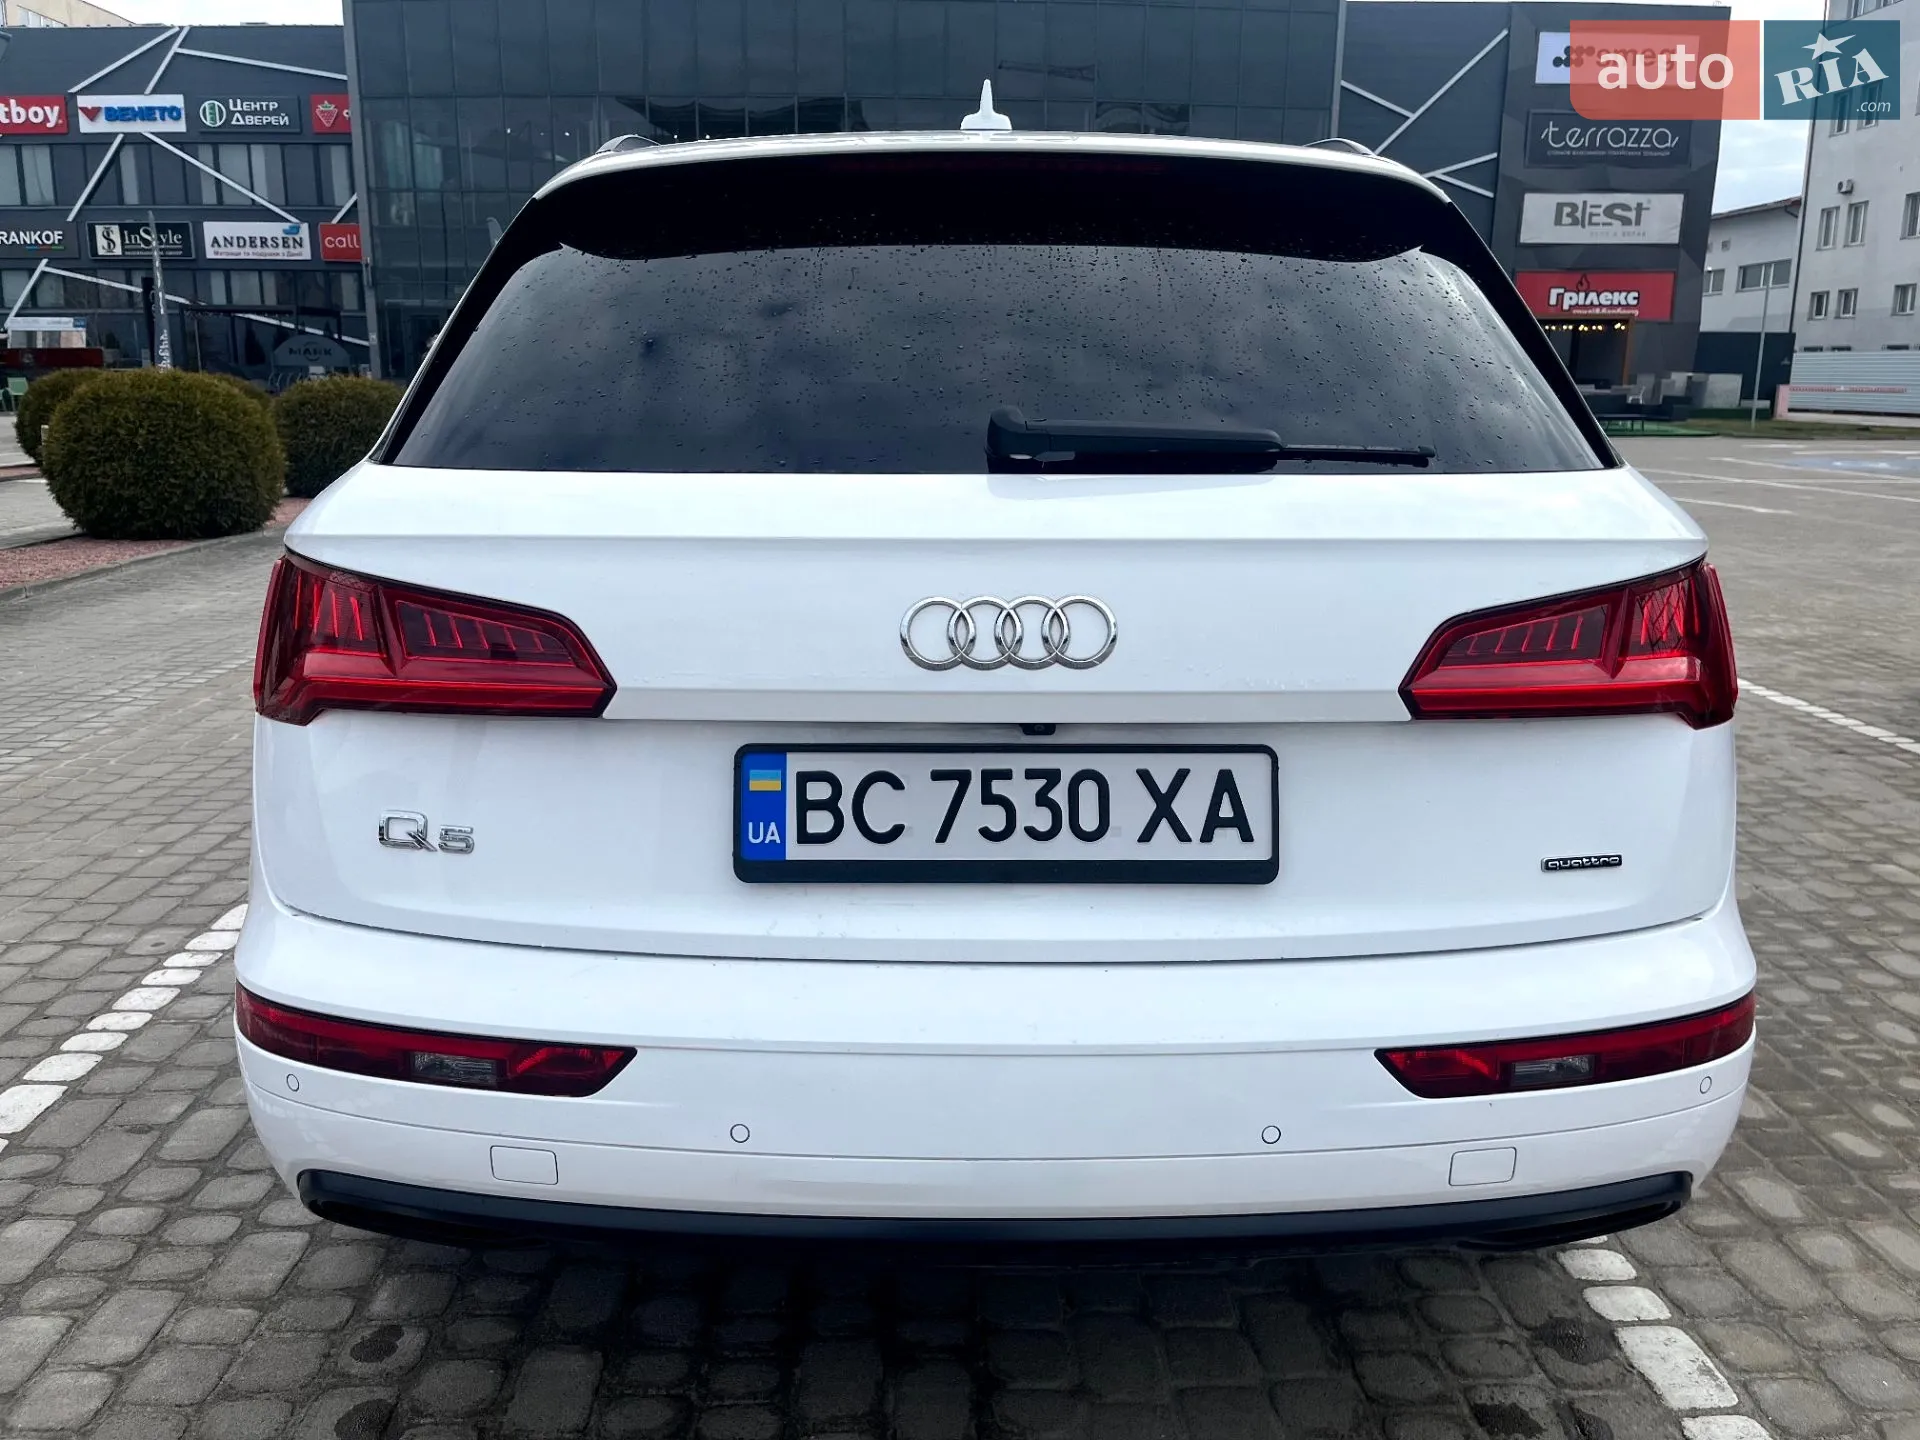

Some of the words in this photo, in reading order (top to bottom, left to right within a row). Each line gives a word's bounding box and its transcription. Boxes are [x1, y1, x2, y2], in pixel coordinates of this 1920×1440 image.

[1541, 121, 1679, 148] terrazza
[211, 236, 304, 249] ANDERSEN
[324, 234, 360, 248] call
[795, 770, 906, 845] BC
[930, 768, 1110, 843] 7530
[1135, 768, 1255, 843] XA
[378, 810, 475, 854] Q5
[747, 822, 781, 844] UA
[1547, 856, 1620, 871] quattro
